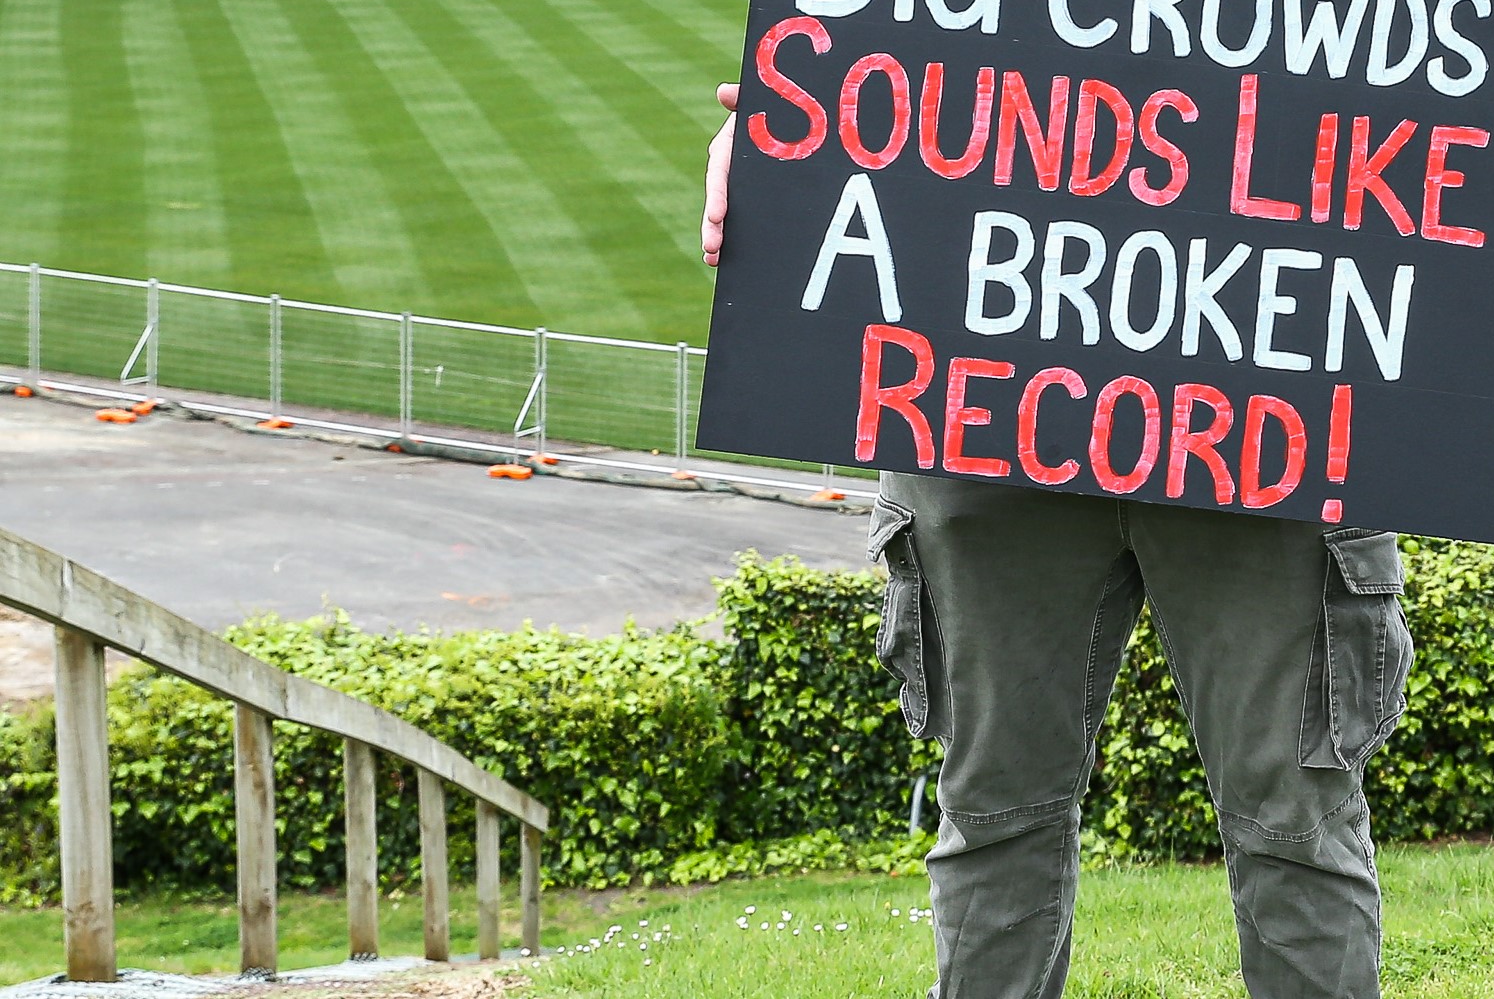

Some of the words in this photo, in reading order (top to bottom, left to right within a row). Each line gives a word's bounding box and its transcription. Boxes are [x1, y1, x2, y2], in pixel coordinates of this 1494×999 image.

[747, 16, 1198, 207] SOUNDS
[1230, 74, 1491, 248] LIKE
[801, 173, 904, 323] A
[966, 211, 1415, 382] BROKEN
[855, 324, 1352, 524] RECORD!
